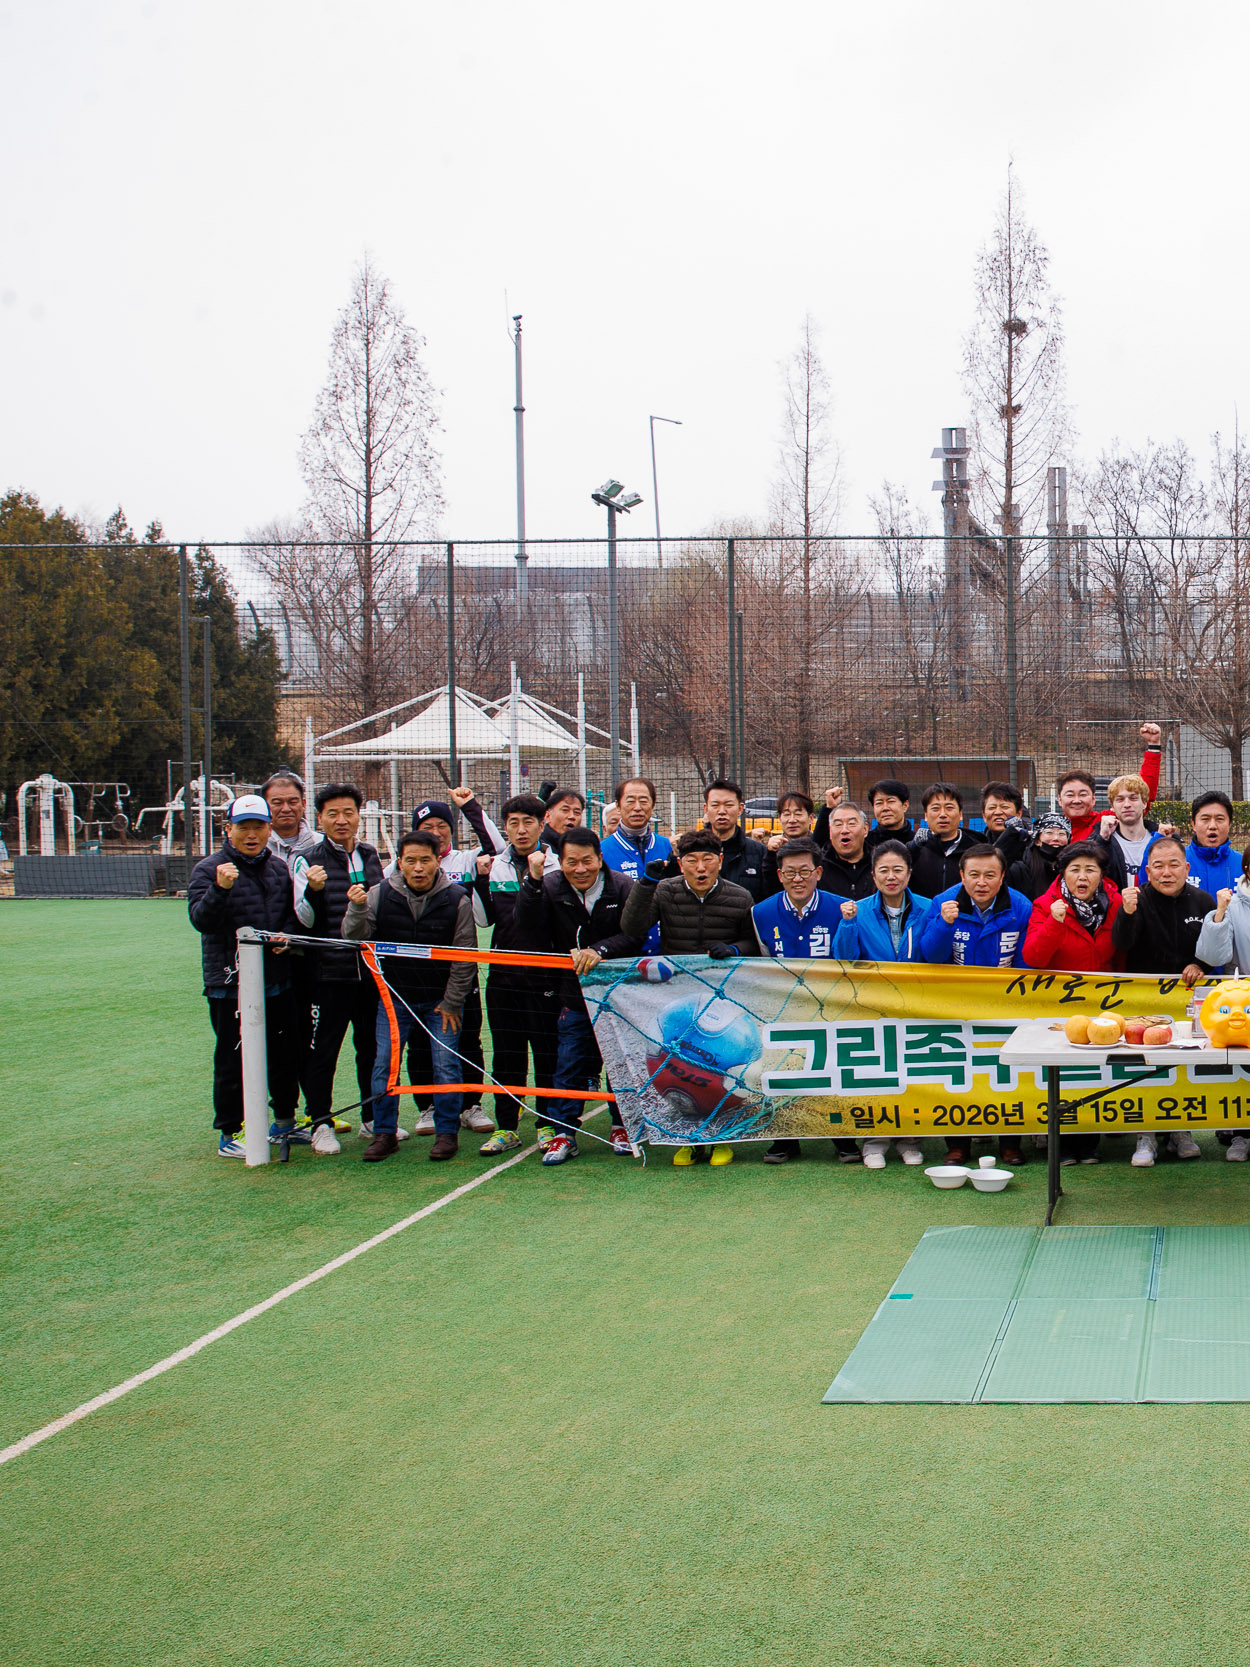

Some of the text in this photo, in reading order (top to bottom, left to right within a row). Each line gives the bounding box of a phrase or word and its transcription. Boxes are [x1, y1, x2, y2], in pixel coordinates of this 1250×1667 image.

[773, 926, 780, 939] 1
[809, 933, 831, 957] 김
[849, 1104, 901, 1129] 일시
[932, 1101, 1025, 1127] 2026년
[1090, 1097, 1144, 1124] 15일
[1155, 1095, 1208, 1122] 오전
